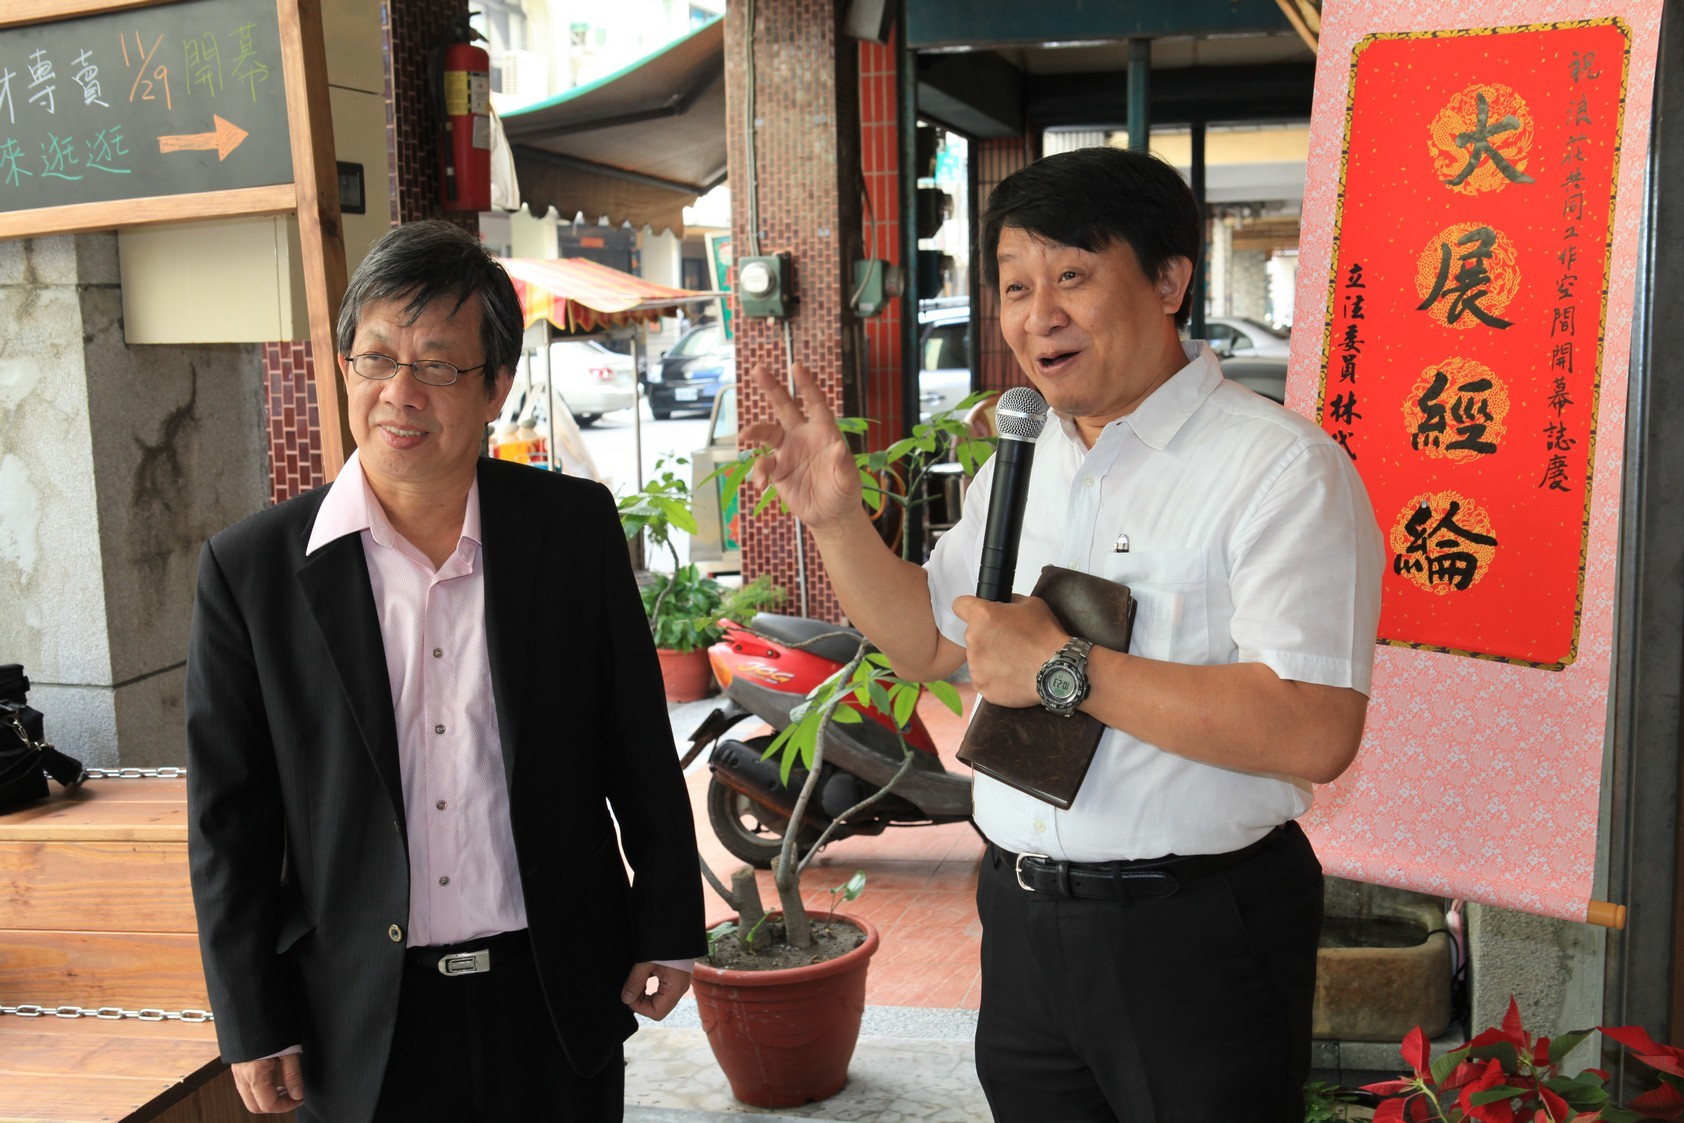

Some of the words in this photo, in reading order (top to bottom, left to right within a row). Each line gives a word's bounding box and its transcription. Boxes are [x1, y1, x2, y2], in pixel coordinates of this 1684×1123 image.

[183, 22, 269, 103] 開幕
[1393, 91, 1537, 591] 大展經綸
